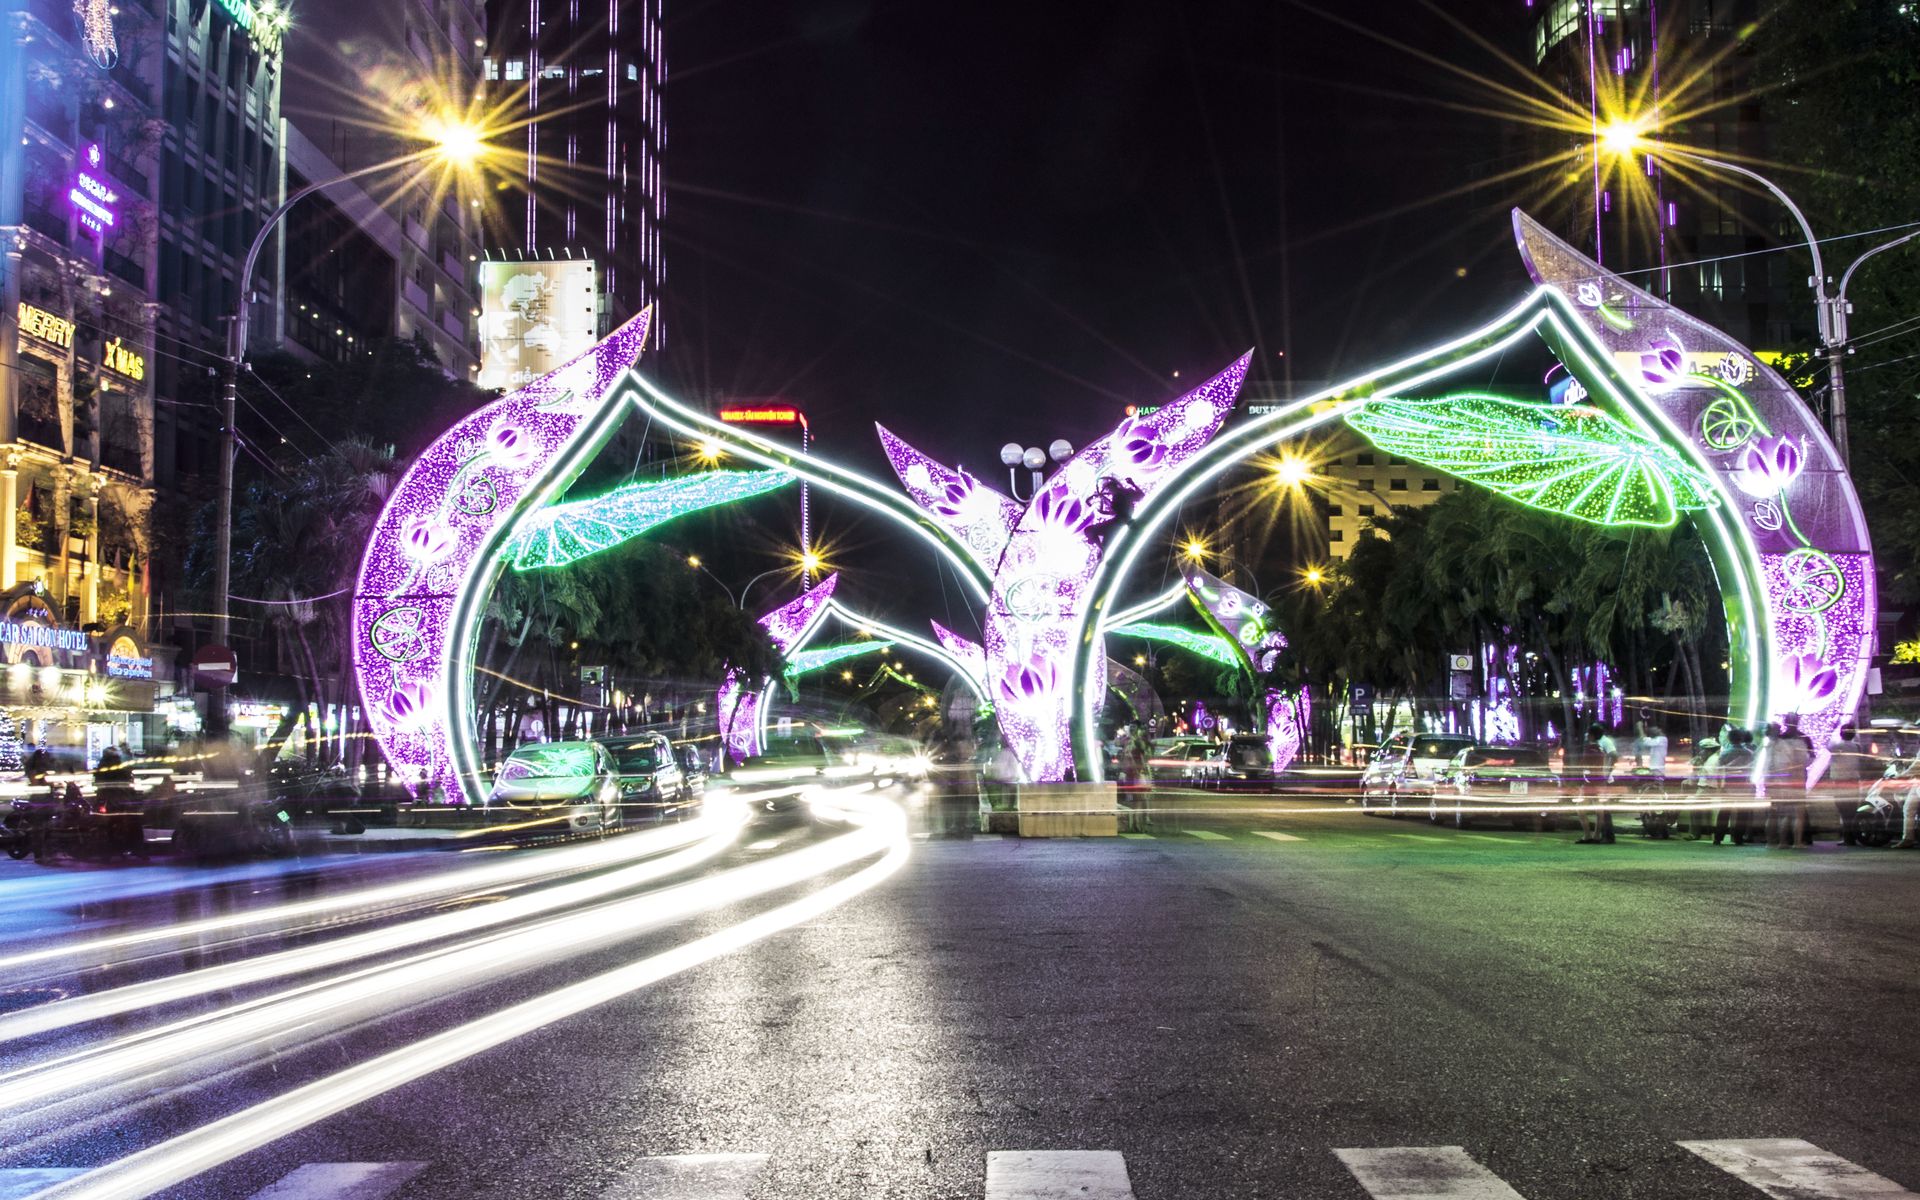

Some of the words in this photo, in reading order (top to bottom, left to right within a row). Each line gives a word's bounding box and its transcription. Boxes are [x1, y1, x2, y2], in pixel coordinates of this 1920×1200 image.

[18, 302, 76, 348] MERRY
[20, 624, 57, 648] SAIGON
[58, 628, 88, 651] HOTEL
[1355, 688, 1365, 700] P
